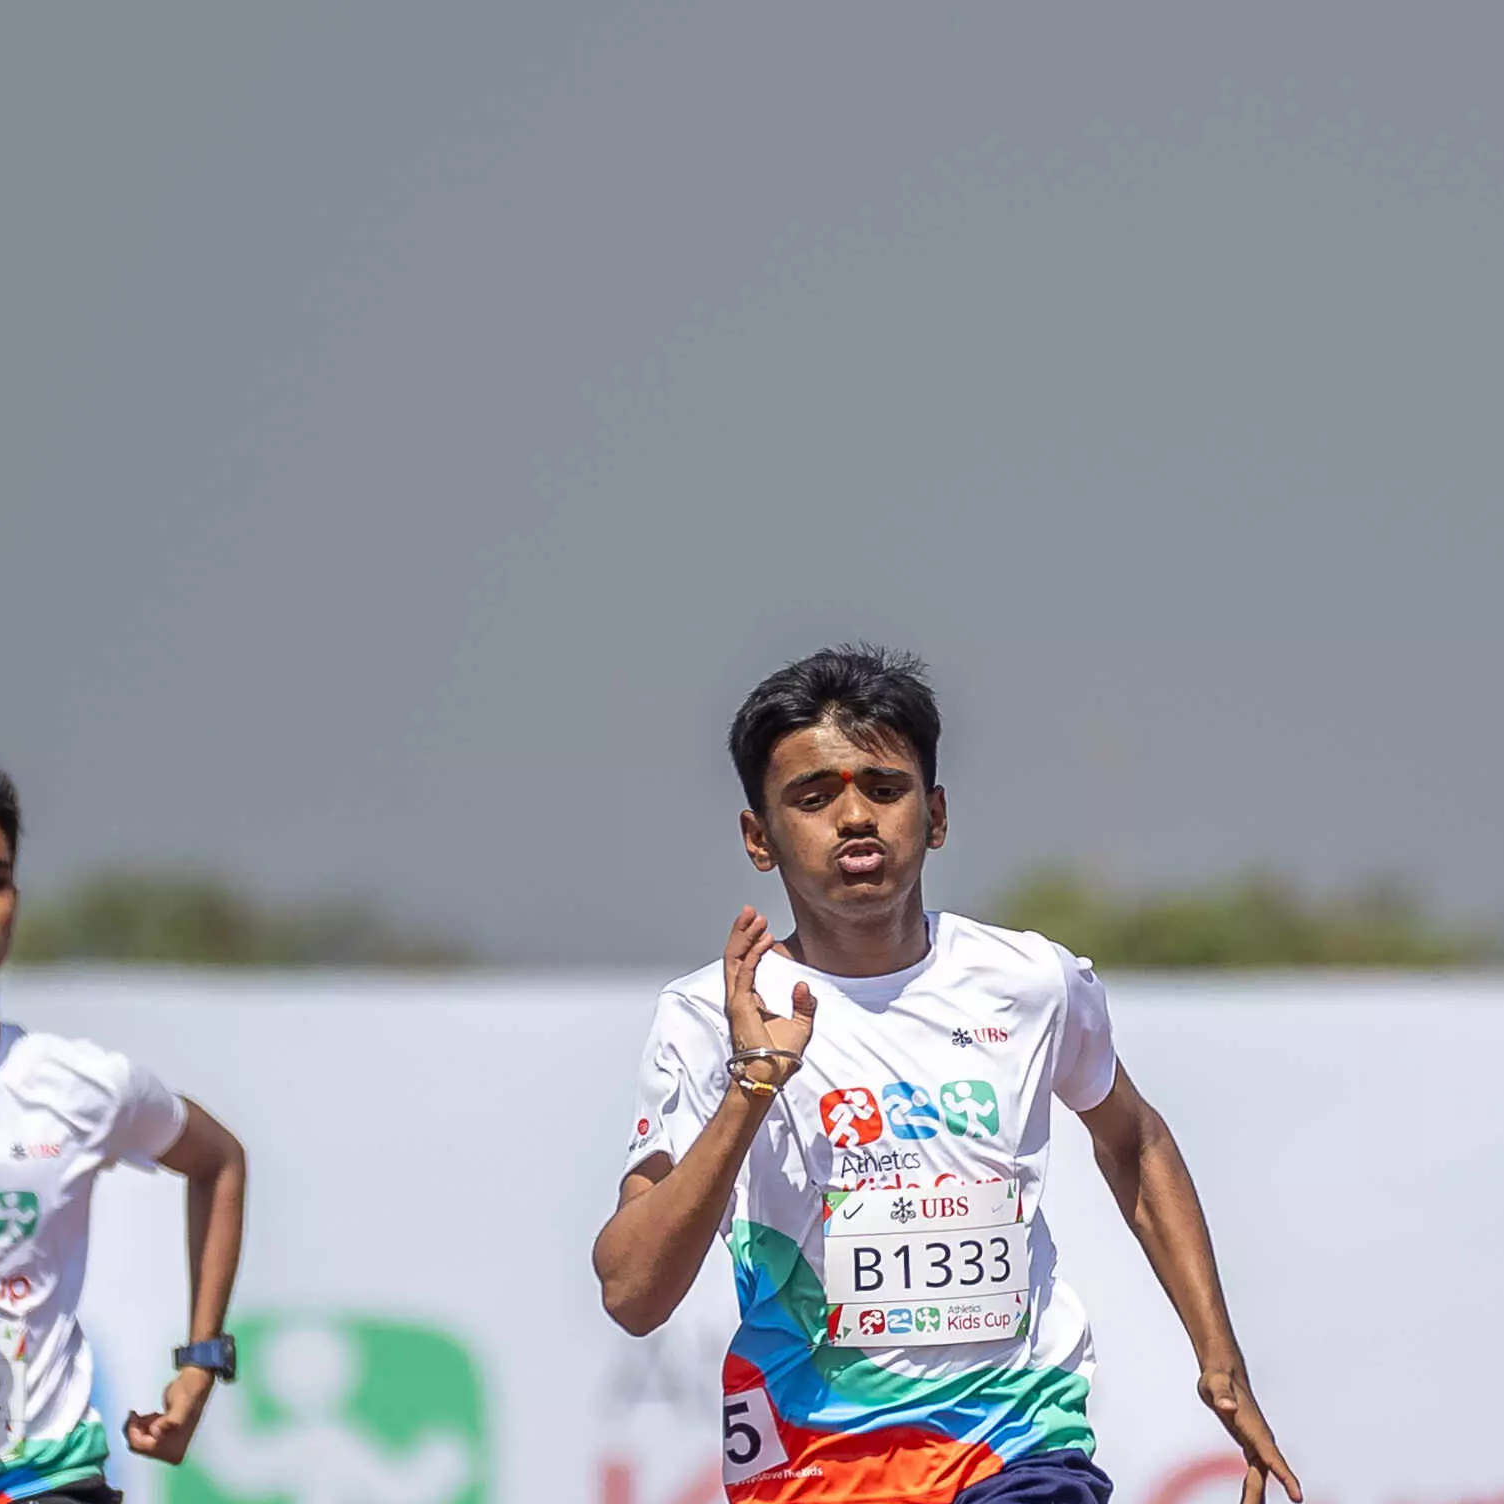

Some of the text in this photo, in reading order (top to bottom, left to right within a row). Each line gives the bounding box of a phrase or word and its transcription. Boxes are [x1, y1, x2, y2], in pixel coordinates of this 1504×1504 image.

[974, 1026, 1008, 1043] UBS
[841, 1150, 920, 1178] Athletics
[920, 1196, 969, 1218] UBS
[853, 1237, 1011, 1292] B1333
[947, 1312, 1011, 1330] Kids Cup
[724, 1402, 761, 1465] 5
